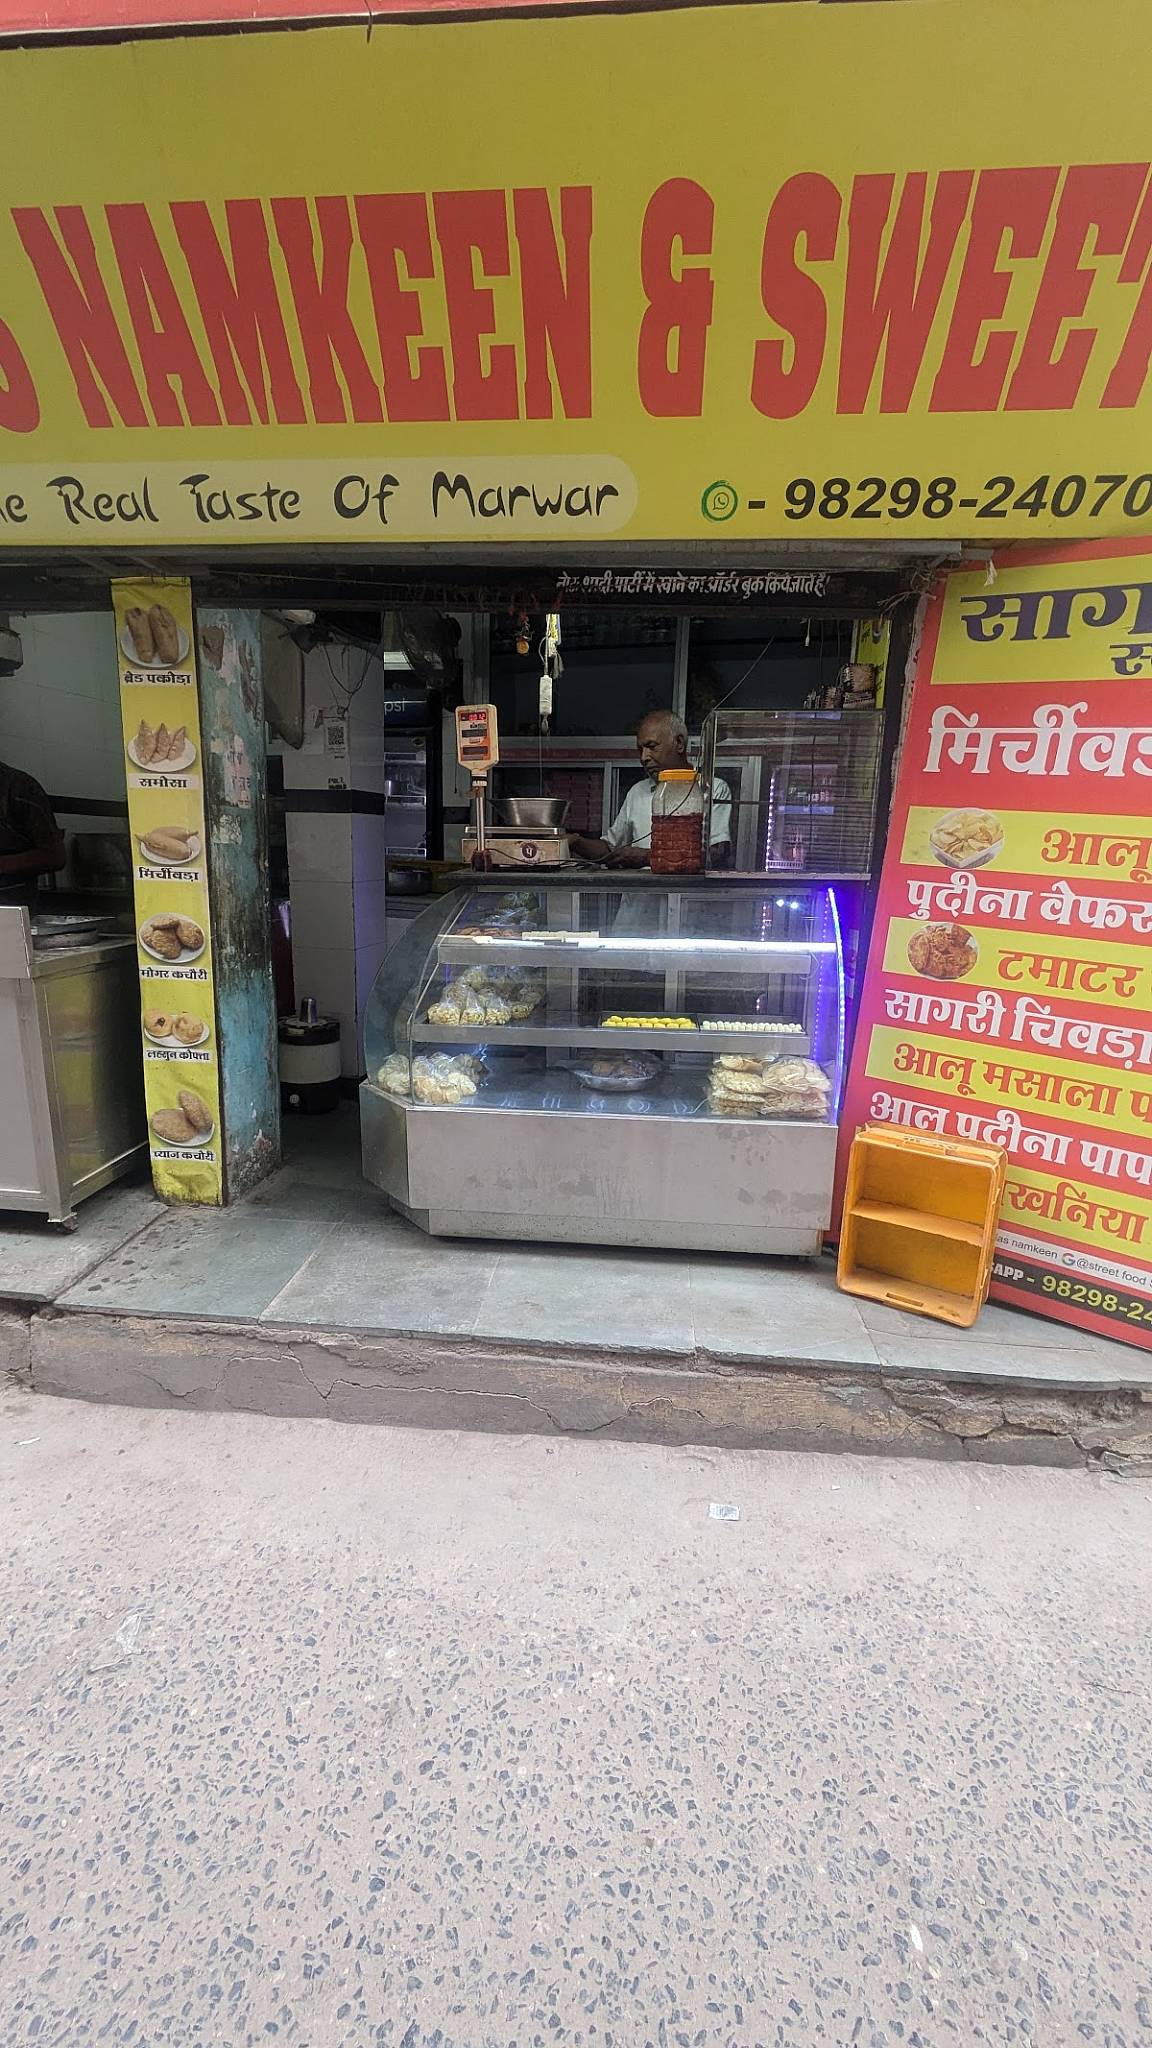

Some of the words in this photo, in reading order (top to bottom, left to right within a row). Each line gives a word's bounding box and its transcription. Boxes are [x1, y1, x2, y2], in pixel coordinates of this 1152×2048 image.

[10, 186, 592, 428] NAMKEEN
[637, 177, 714, 418] &
[0, 494, 28, 523] e
[46, 476, 159, 524] Real
[180, 474, 300, 524] Taste
[333, 474, 400, 525] Of
[432, 471, 619, 518] Marwar
[784, 474, 1152, 520] 98298-24070
[139, 776, 187, 788] समोसा
[907, 872, 1033, 919] पुदीना
[998, 949, 1143, 998] टमाटर
[884, 989, 1007, 1038] सागरी
[893, 1043, 977, 1096] आलू
[982, 1059, 1123, 1117] मसाला
[1001, 1179, 1149, 1244] खनिया
[1011, 1238, 1058, 1260] namkeen
[1121, 1271, 1146, 1286] food
